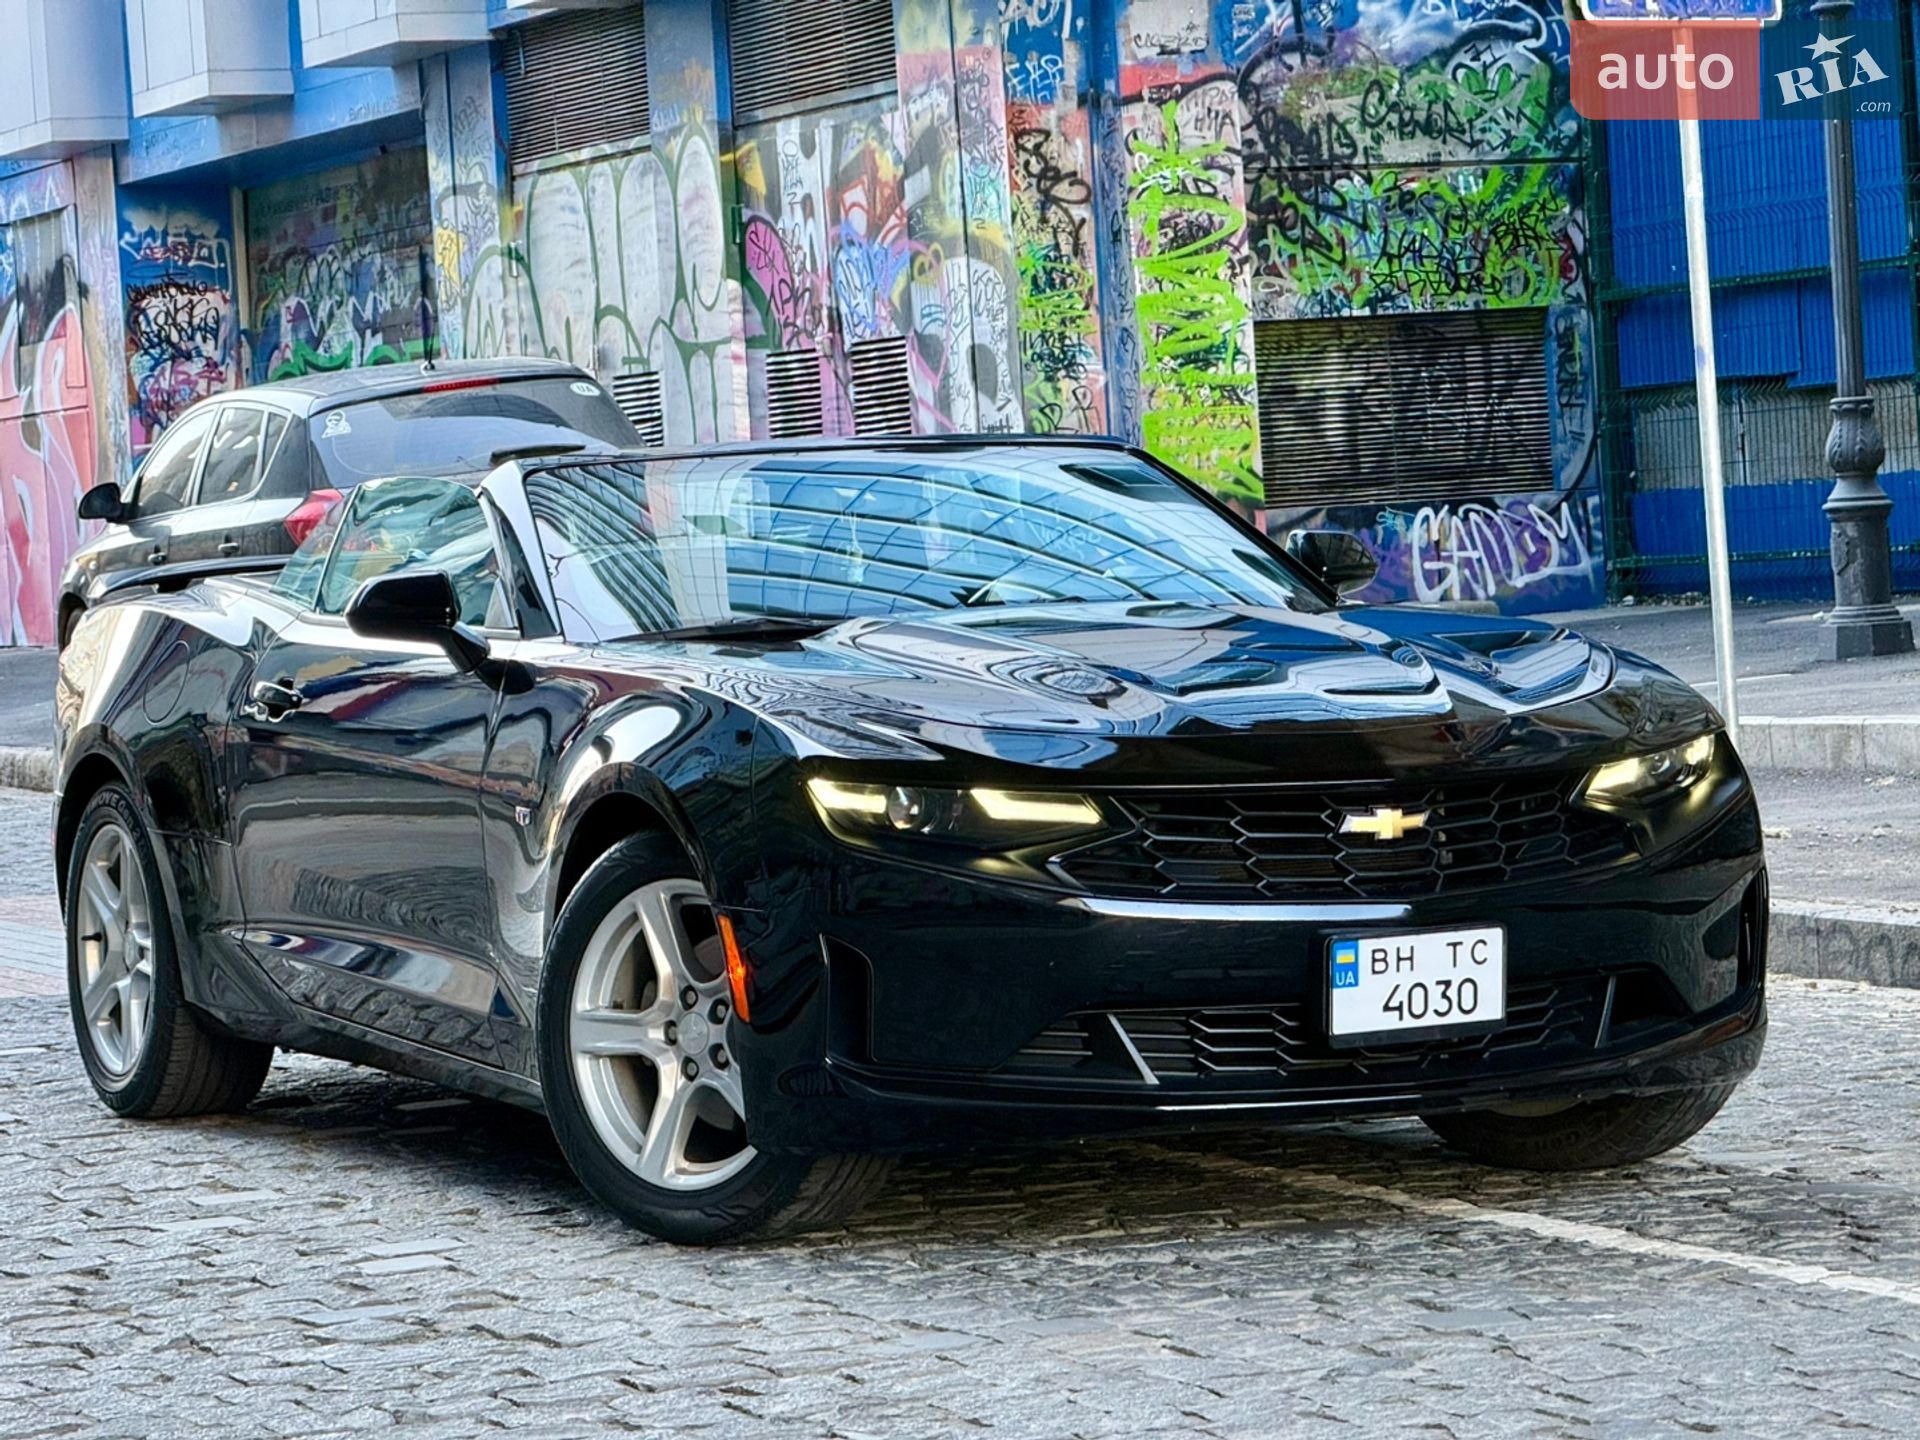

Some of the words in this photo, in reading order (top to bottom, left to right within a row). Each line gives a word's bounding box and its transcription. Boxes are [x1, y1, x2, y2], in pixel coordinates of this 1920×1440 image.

[1371, 945, 1414, 975] BH
[1446, 939, 1488, 968] TC
[1335, 970, 1356, 986] UA
[1382, 977, 1478, 1021] 4030
